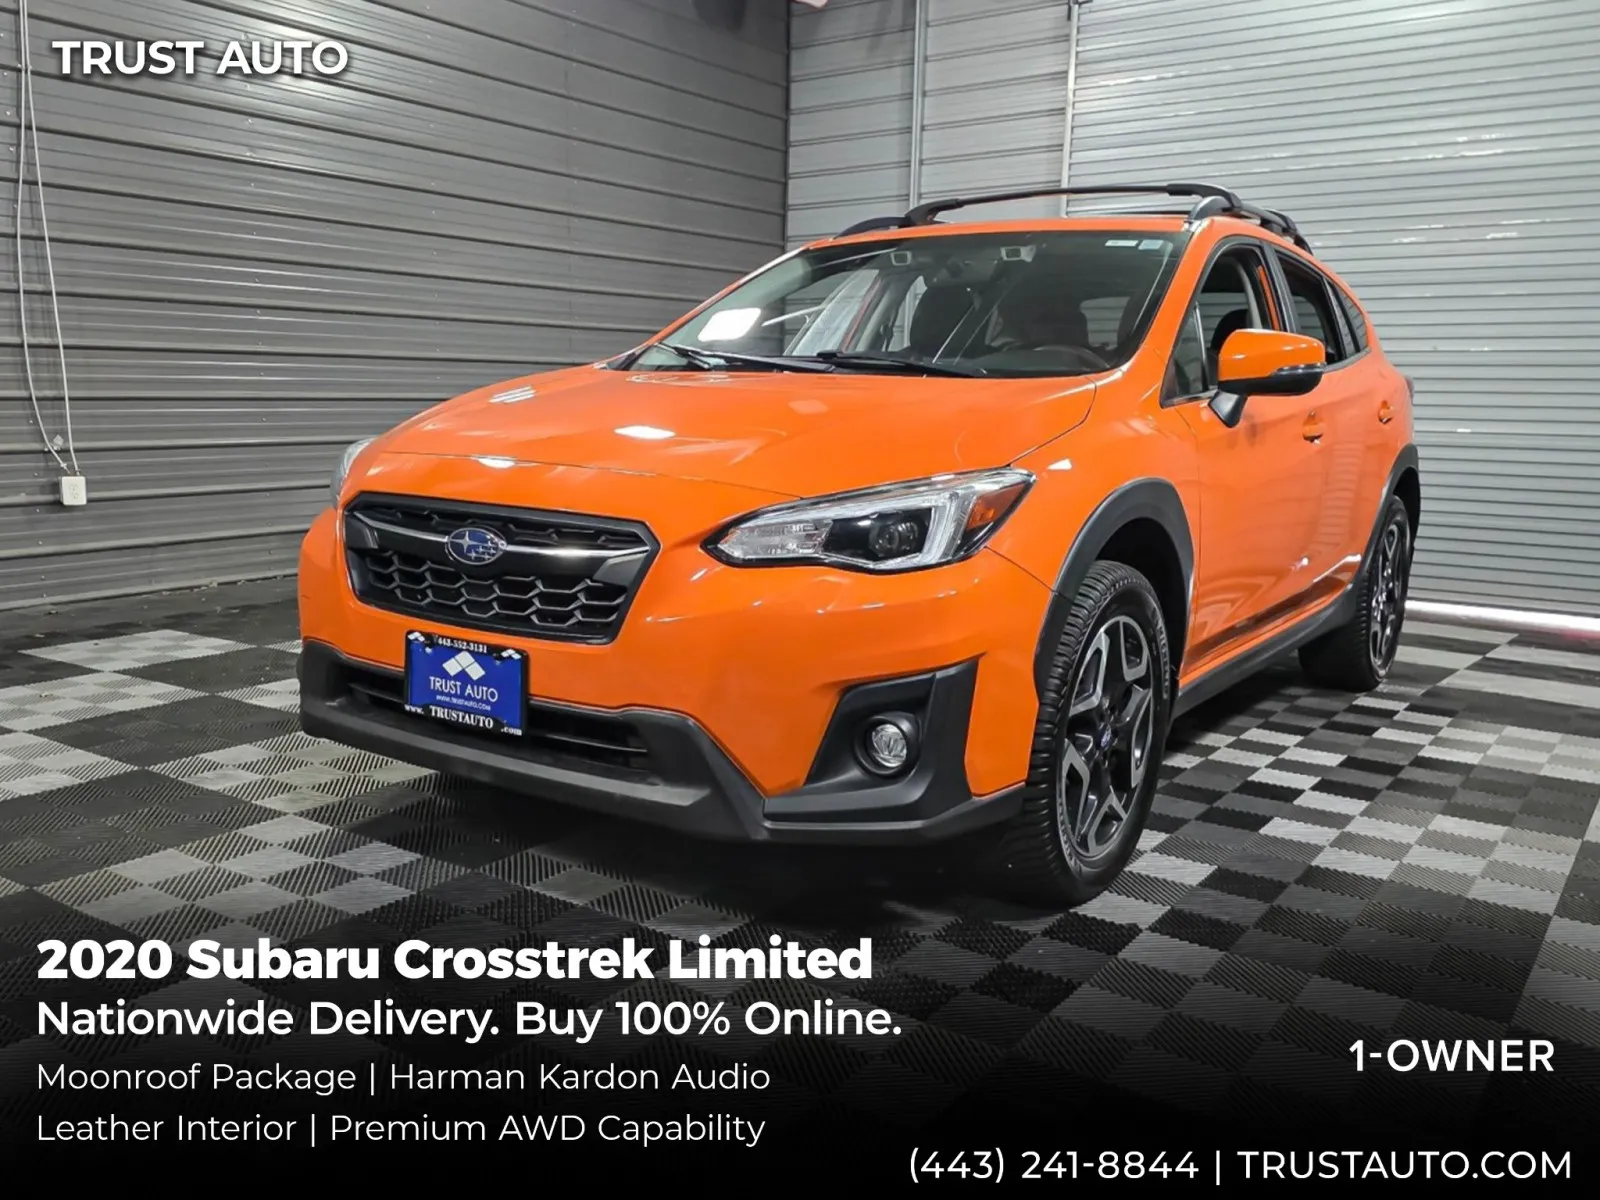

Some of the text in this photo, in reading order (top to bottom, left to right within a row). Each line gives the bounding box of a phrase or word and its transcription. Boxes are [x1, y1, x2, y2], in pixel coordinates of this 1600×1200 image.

[437, 637, 488, 653] 443-552-3131
[429, 676, 498, 702] TRUST AUTO
[429, 705, 494, 729] TRUSTAUTO
[500, 726, 522, 736] .com
